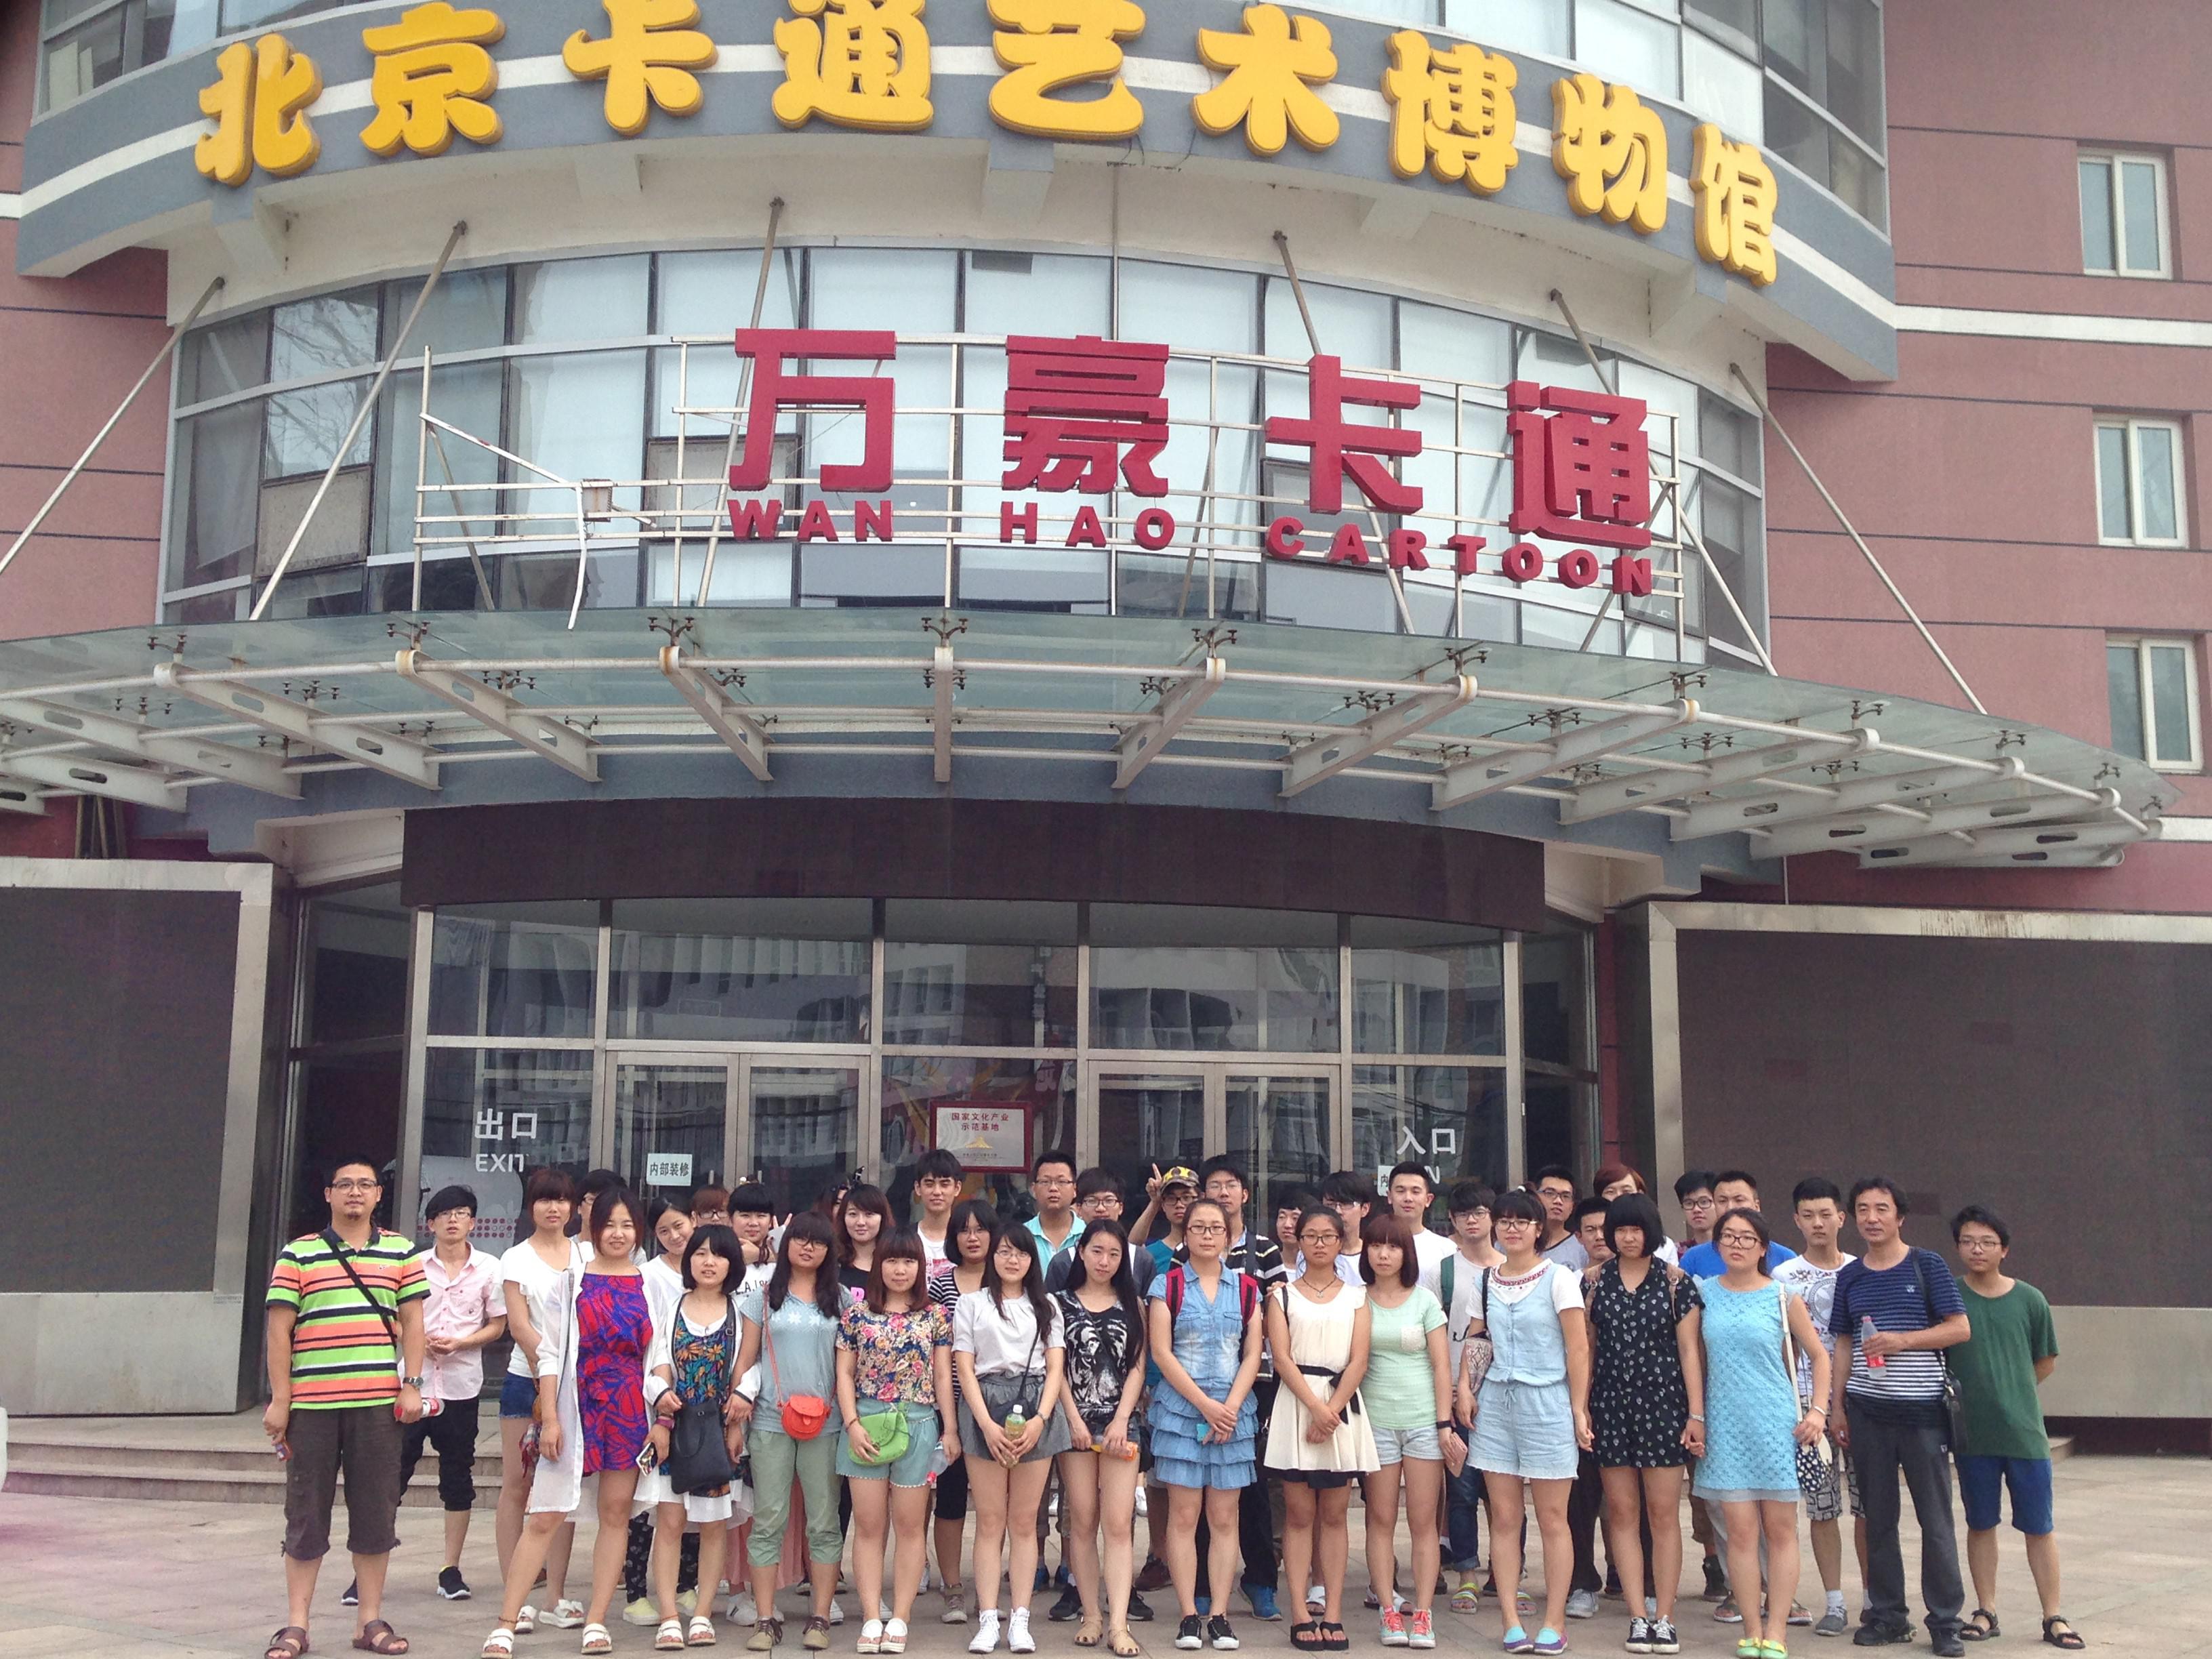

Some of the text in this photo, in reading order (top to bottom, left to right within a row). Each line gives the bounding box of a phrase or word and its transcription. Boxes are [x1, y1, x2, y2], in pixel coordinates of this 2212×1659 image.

[193, 0, 1778, 286] 北京卡通艺术博物馆
[729, 328, 1652, 549] 万豪卡通
[727, 499, 1652, 596] WAN HAO CARTOON
[475, 1108, 537, 1141] 出口
[951, 1112, 1009, 1122] 国家文化产业
[961, 1122, 1000, 1131] 示范基地
[1397, 1126, 1456, 1154] 入口
[649, 1162, 689, 1177] 内部装修
